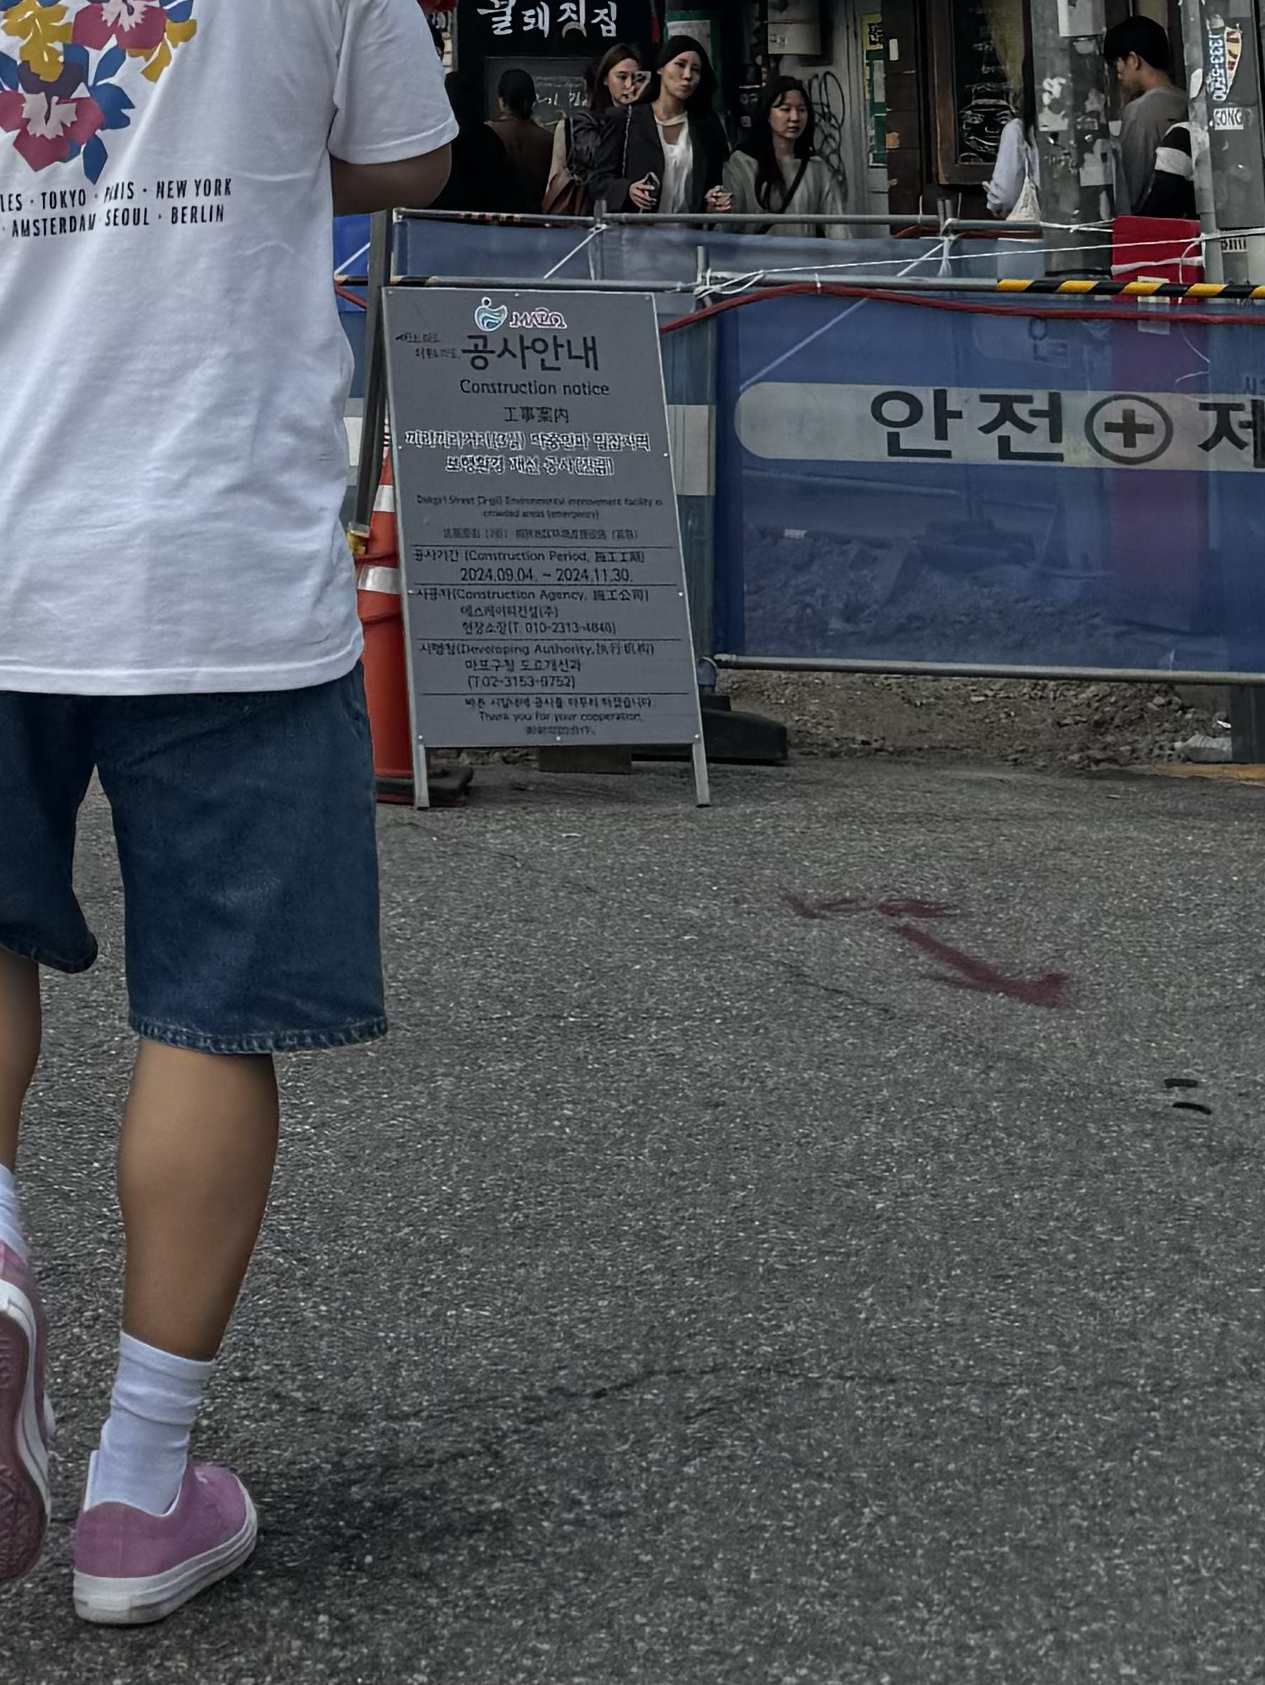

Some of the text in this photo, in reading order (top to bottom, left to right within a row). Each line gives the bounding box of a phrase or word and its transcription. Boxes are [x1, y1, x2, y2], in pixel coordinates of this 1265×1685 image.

[41, 188, 87, 210] TOKYO
[156, 180, 187, 199] NEW
[194, 178, 233, 198] YORK
[104, 204, 150, 227] SEOUL
[170, 203, 225, 225] BERLIN
[461, 334, 599, 371] 공사안내
[460, 379, 610, 397] Construction notice
[870, 388, 1064, 463] 안전
[415, 549, 459, 563] 공사기간
[556, 567, 633, 583] 2024.11.30.
[465, 659, 514, 672] 마포구청
